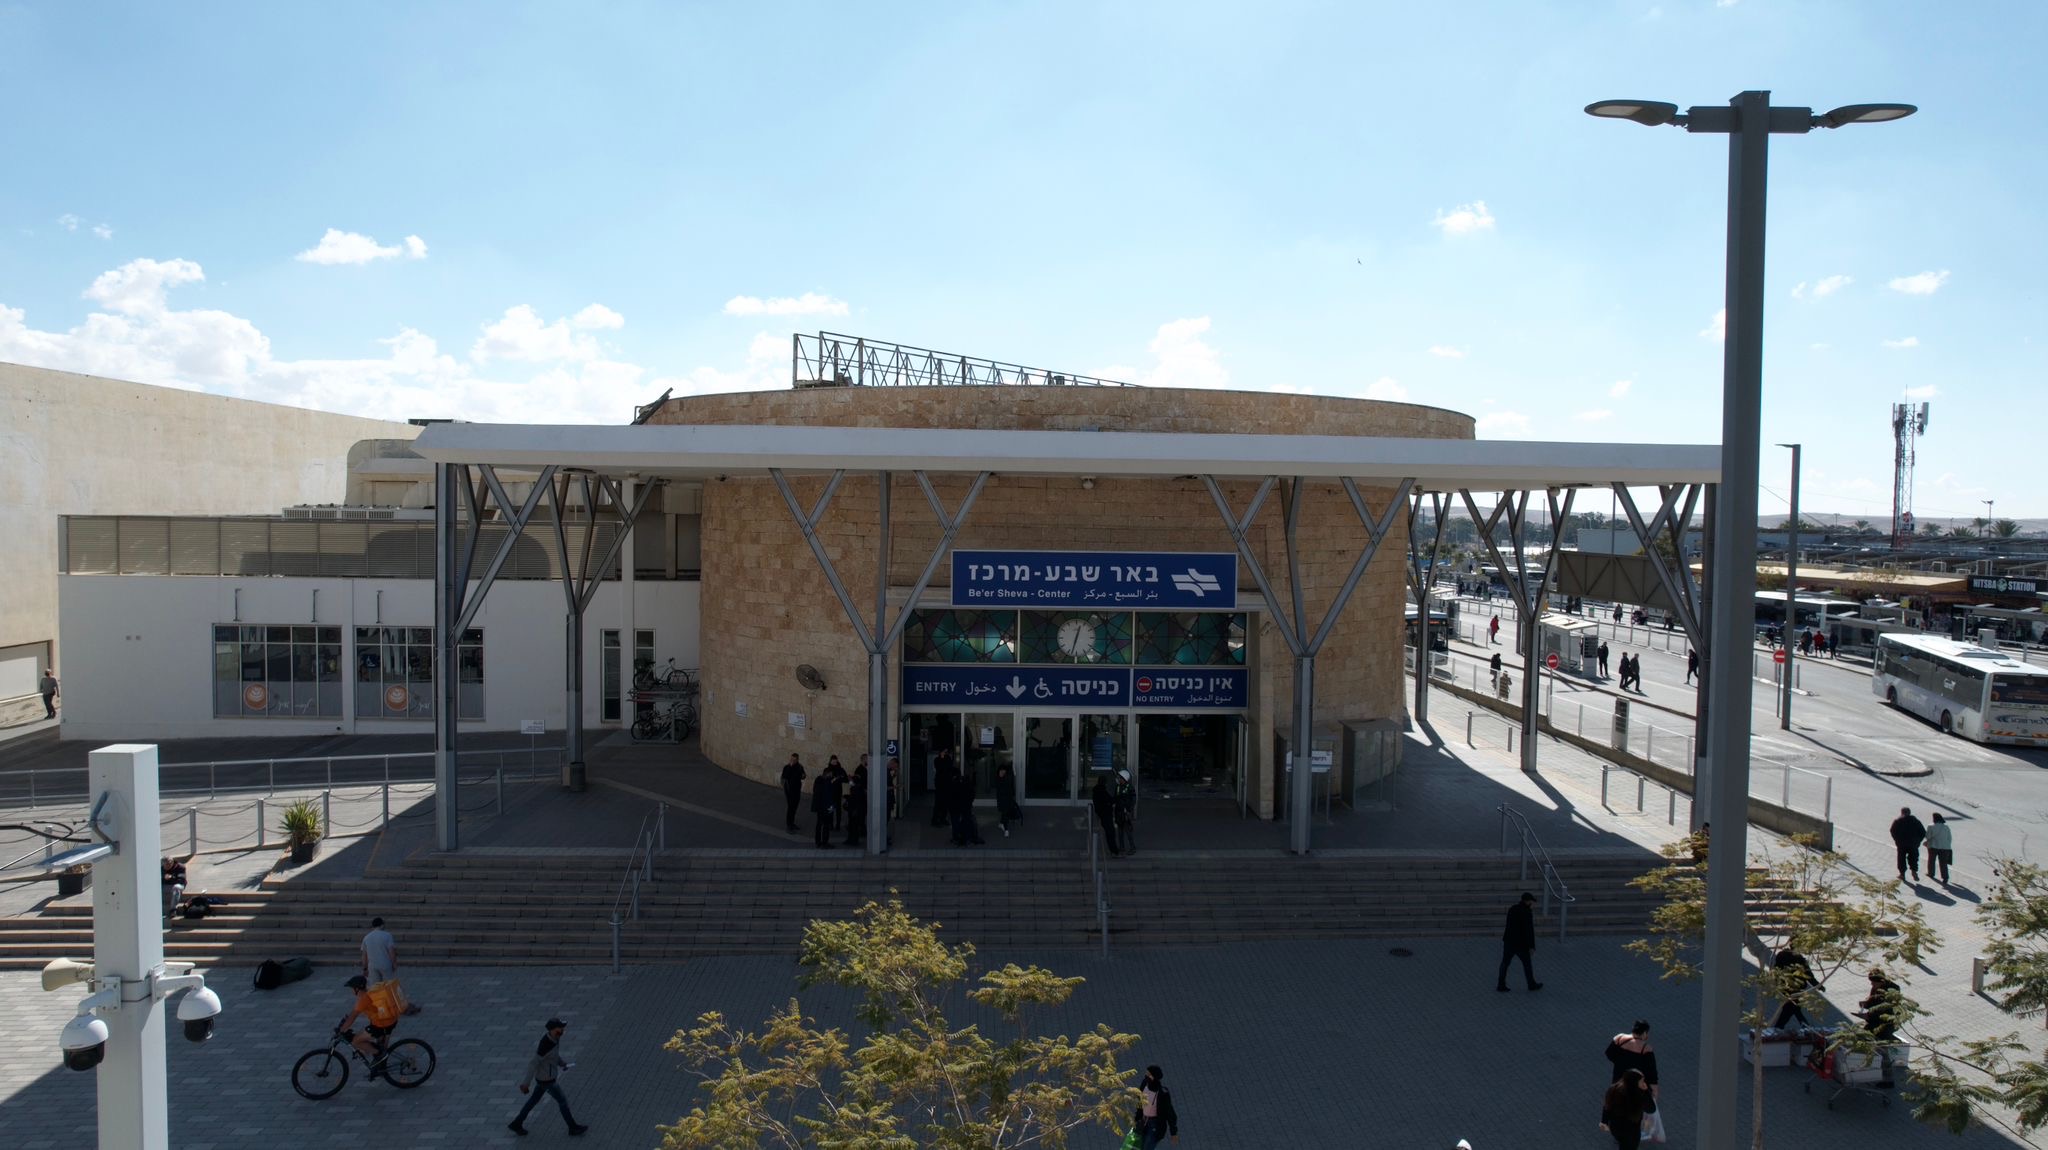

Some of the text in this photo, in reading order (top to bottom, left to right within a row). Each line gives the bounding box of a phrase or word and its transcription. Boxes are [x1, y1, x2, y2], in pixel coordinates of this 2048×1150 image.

[968, 564, 1159, 582] באר שבע-מרכז
[1973, 578, 2037, 592] NITSBA STATION
[968, 588, 995, 598] Be'er
[997, 589, 1028, 598] Sheva
[1037, 589, 1072, 599] Center
[1083, 588, 1107, 600] مركز
[1115, 589, 1143, 602] السبع
[1145, 590, 1159, 600] بئر
[916, 682, 957, 692] ENTRY
[965, 681, 997, 696] دخول
[1061, 679, 1119, 696] כניסה
[1155, 677, 1233, 693] אין כניסה
[1136, 695, 1175, 704] NO ENTRY
